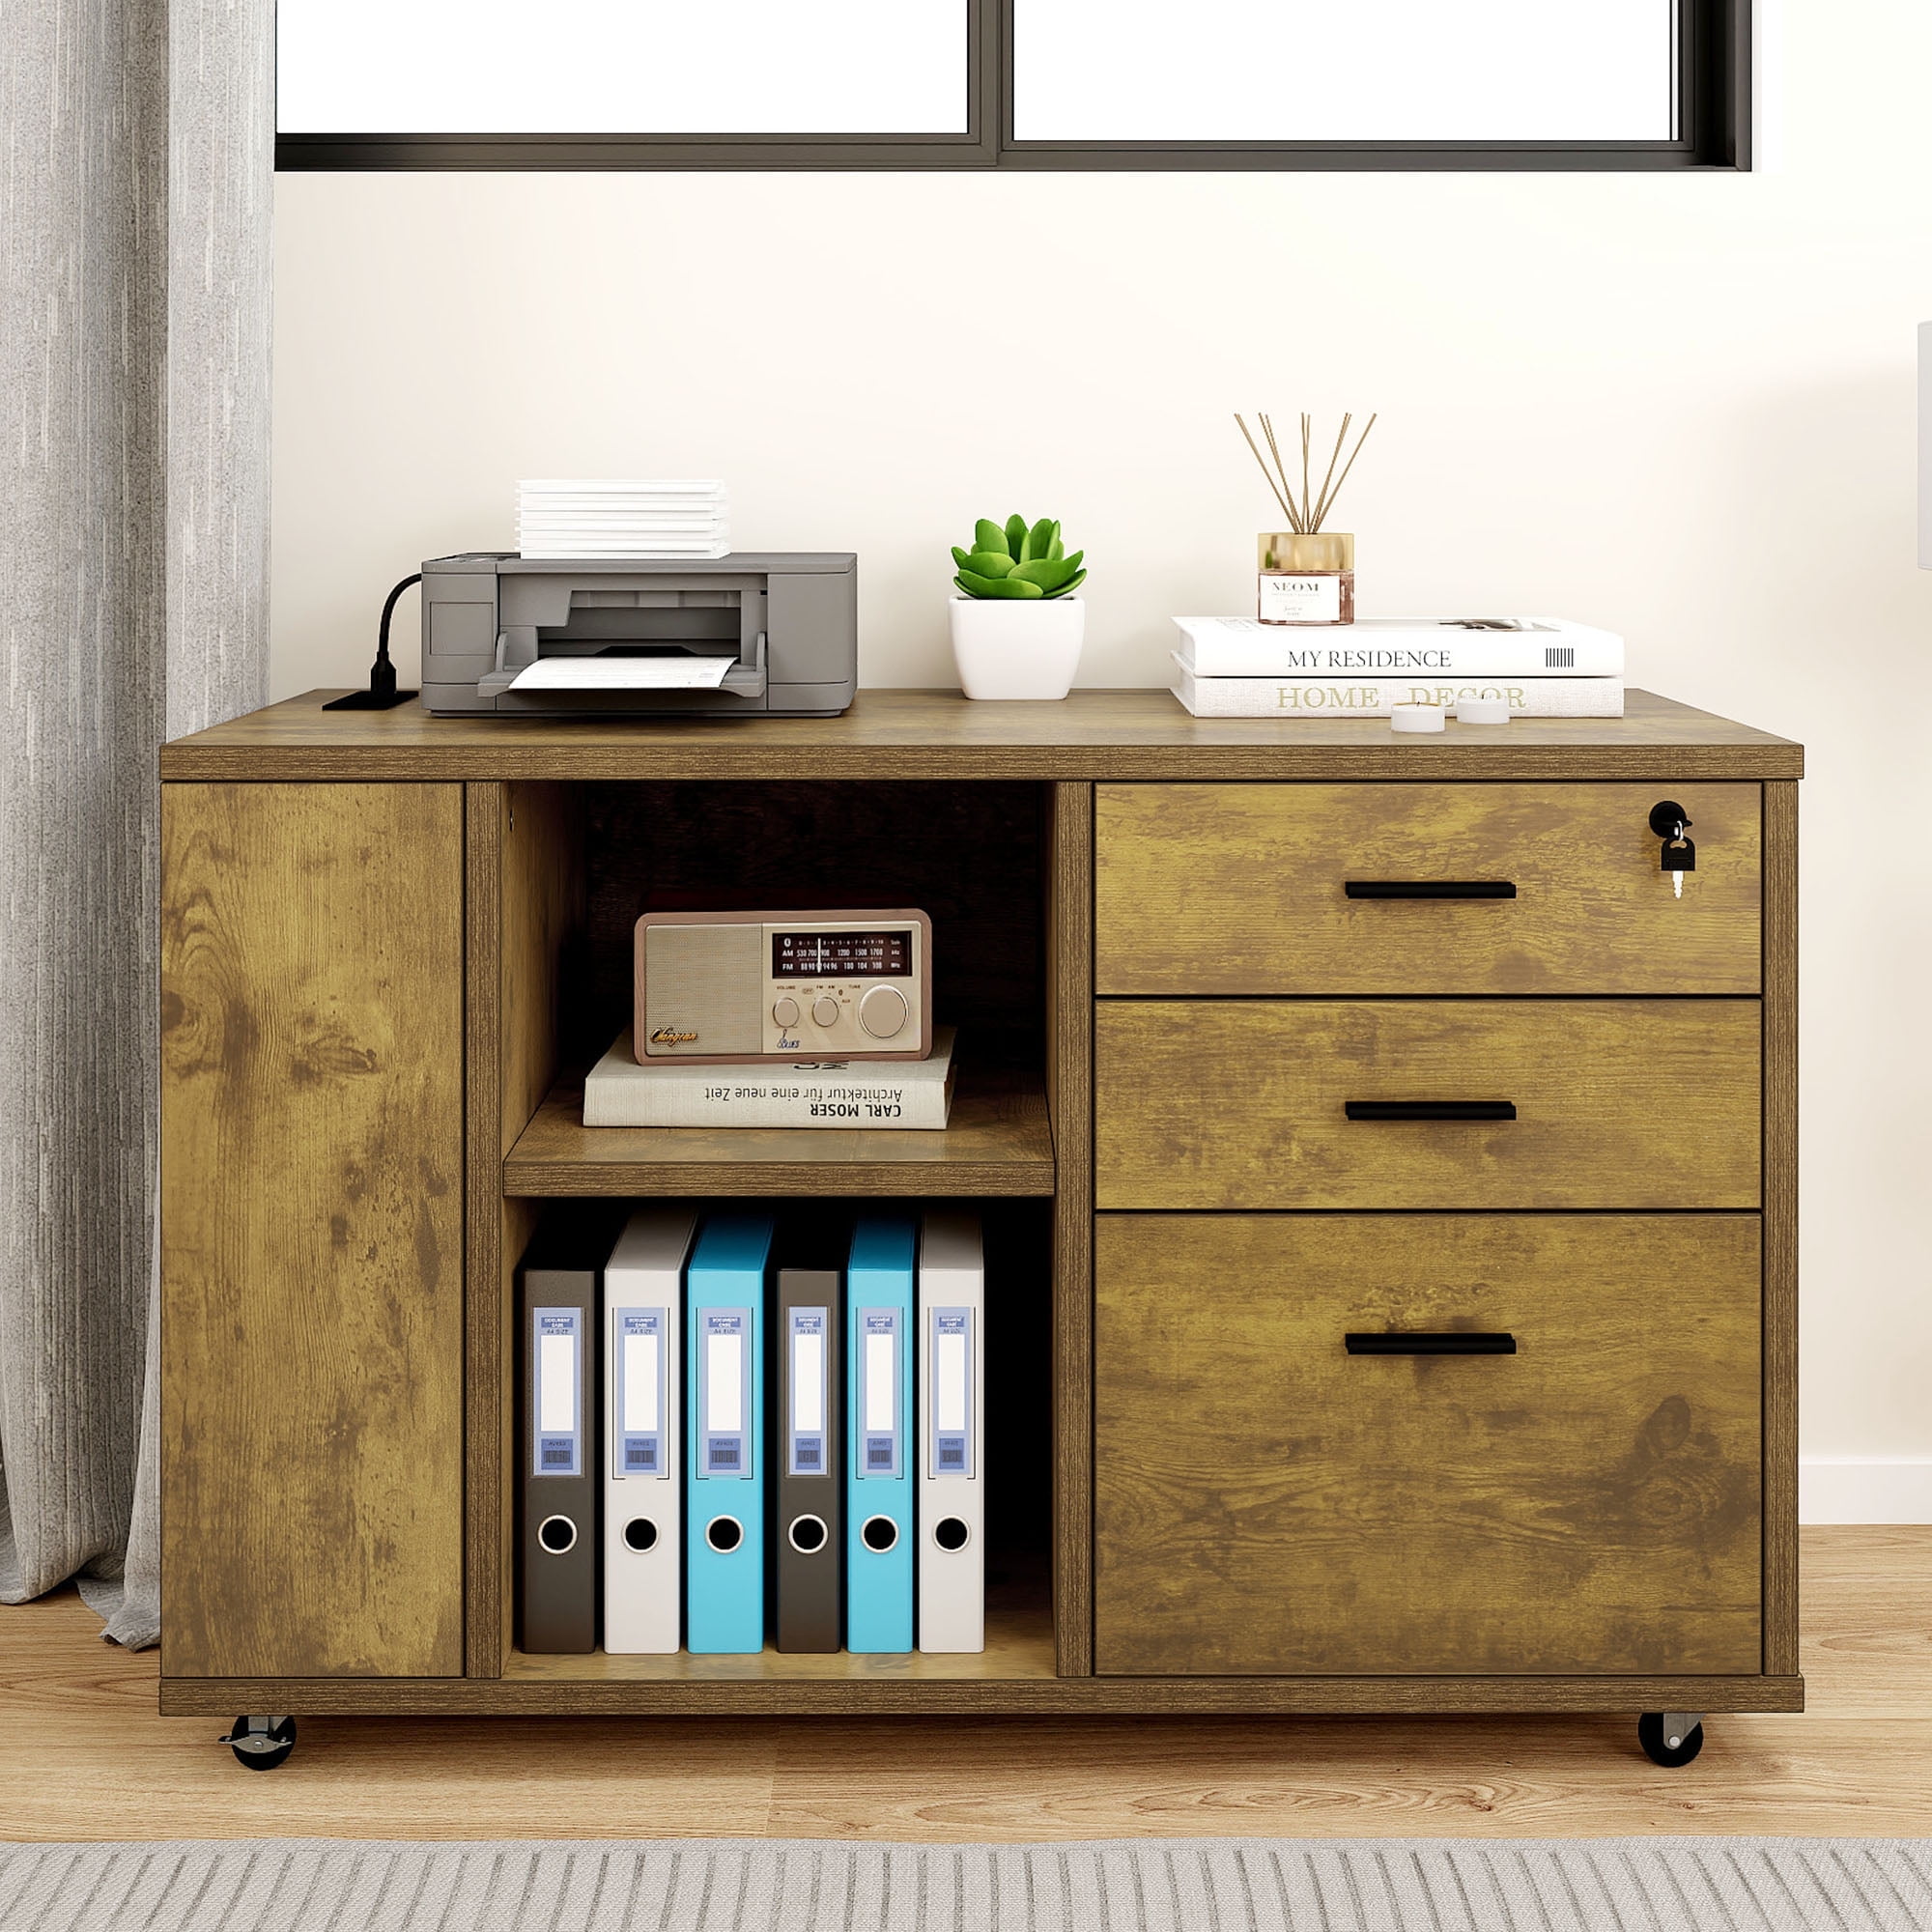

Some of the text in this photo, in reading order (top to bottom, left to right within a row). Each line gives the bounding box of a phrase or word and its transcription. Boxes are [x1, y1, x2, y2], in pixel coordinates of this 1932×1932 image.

[1272, 582, 1319, 591] NEOM
[1288, 650, 1452, 668] MY RESIDENCE
[1276, 687, 1379, 708] HOME
[797, 949, 807, 957] 530
[855, 948, 867, 956] 1500
[869, 948, 883, 956] 1700
[705, 1088, 902, 1102] Architektur für eine neue Zeit
[810, 1103, 901, 1118] CARL MOSER
